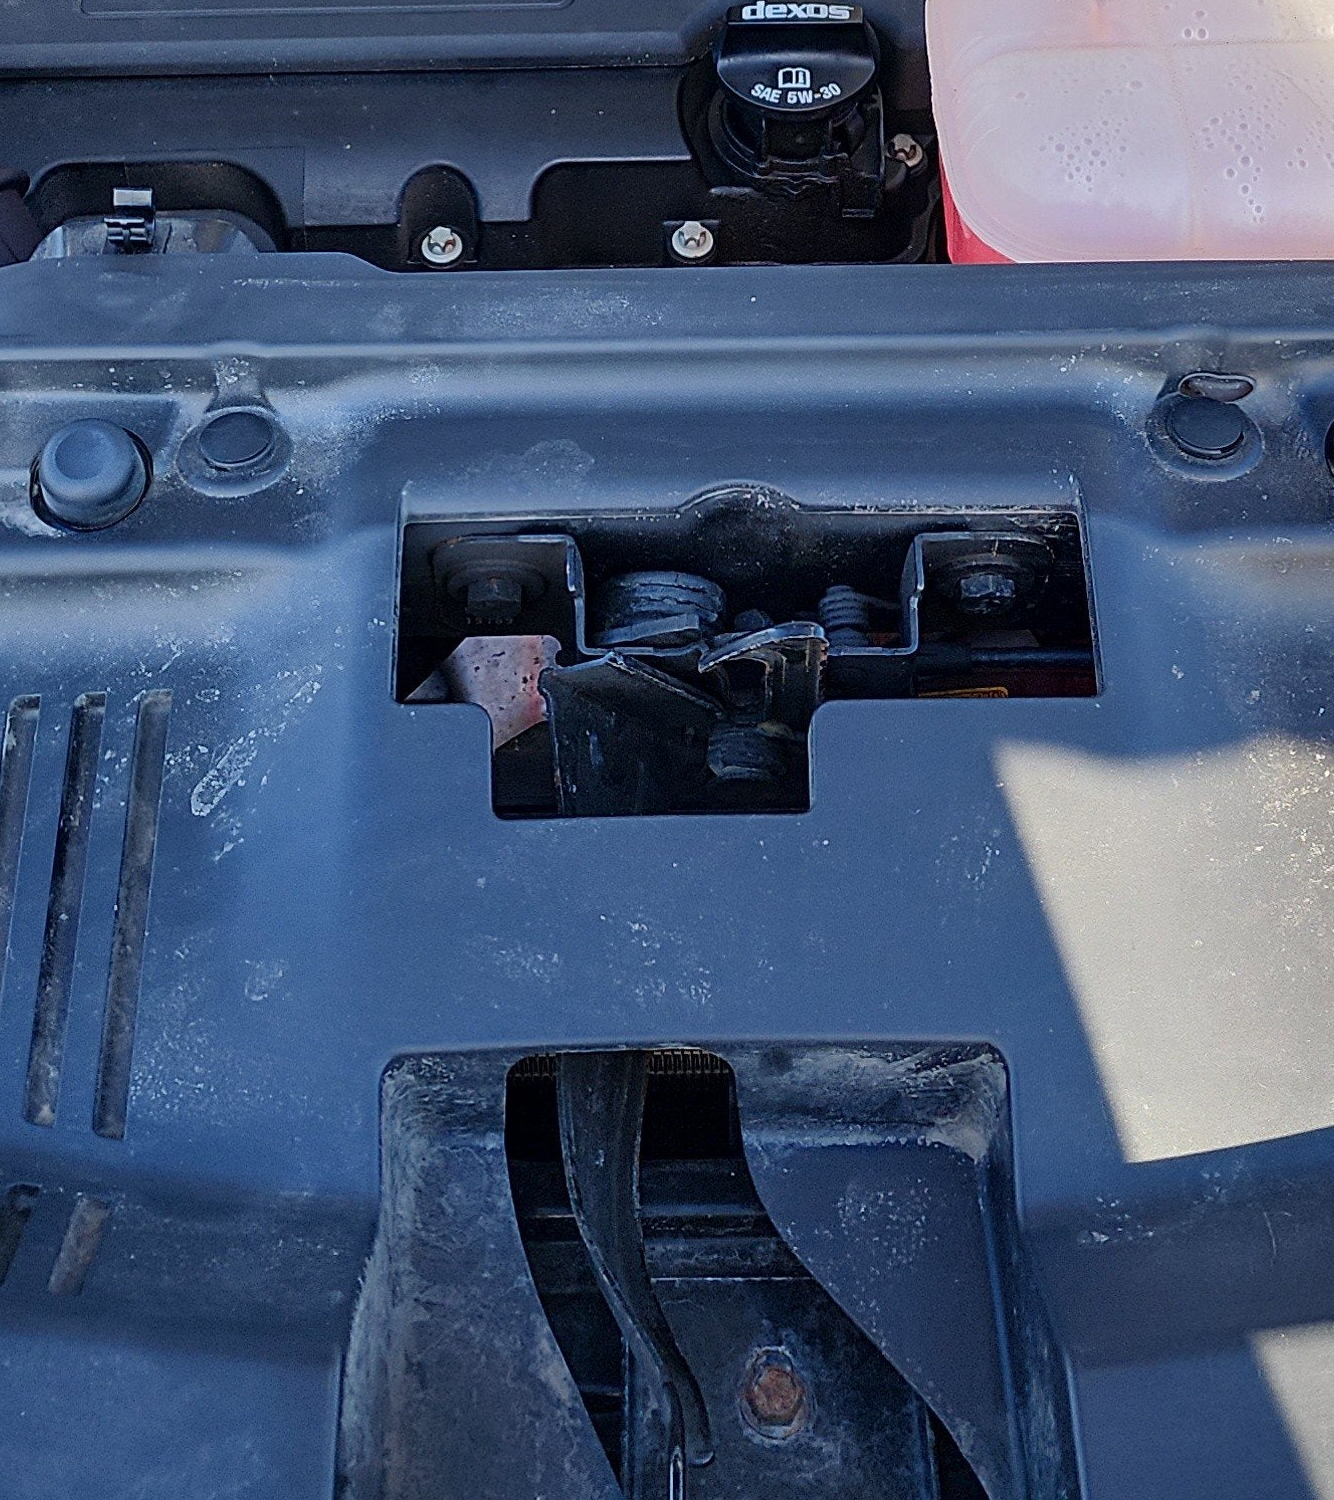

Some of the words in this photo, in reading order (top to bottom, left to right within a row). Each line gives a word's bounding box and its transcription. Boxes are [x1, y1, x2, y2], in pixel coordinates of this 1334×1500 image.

[742, 0, 852, 20] dexos
[750, 83, 782, 104] SAE
[787, 83, 842, 104] 5W-30
